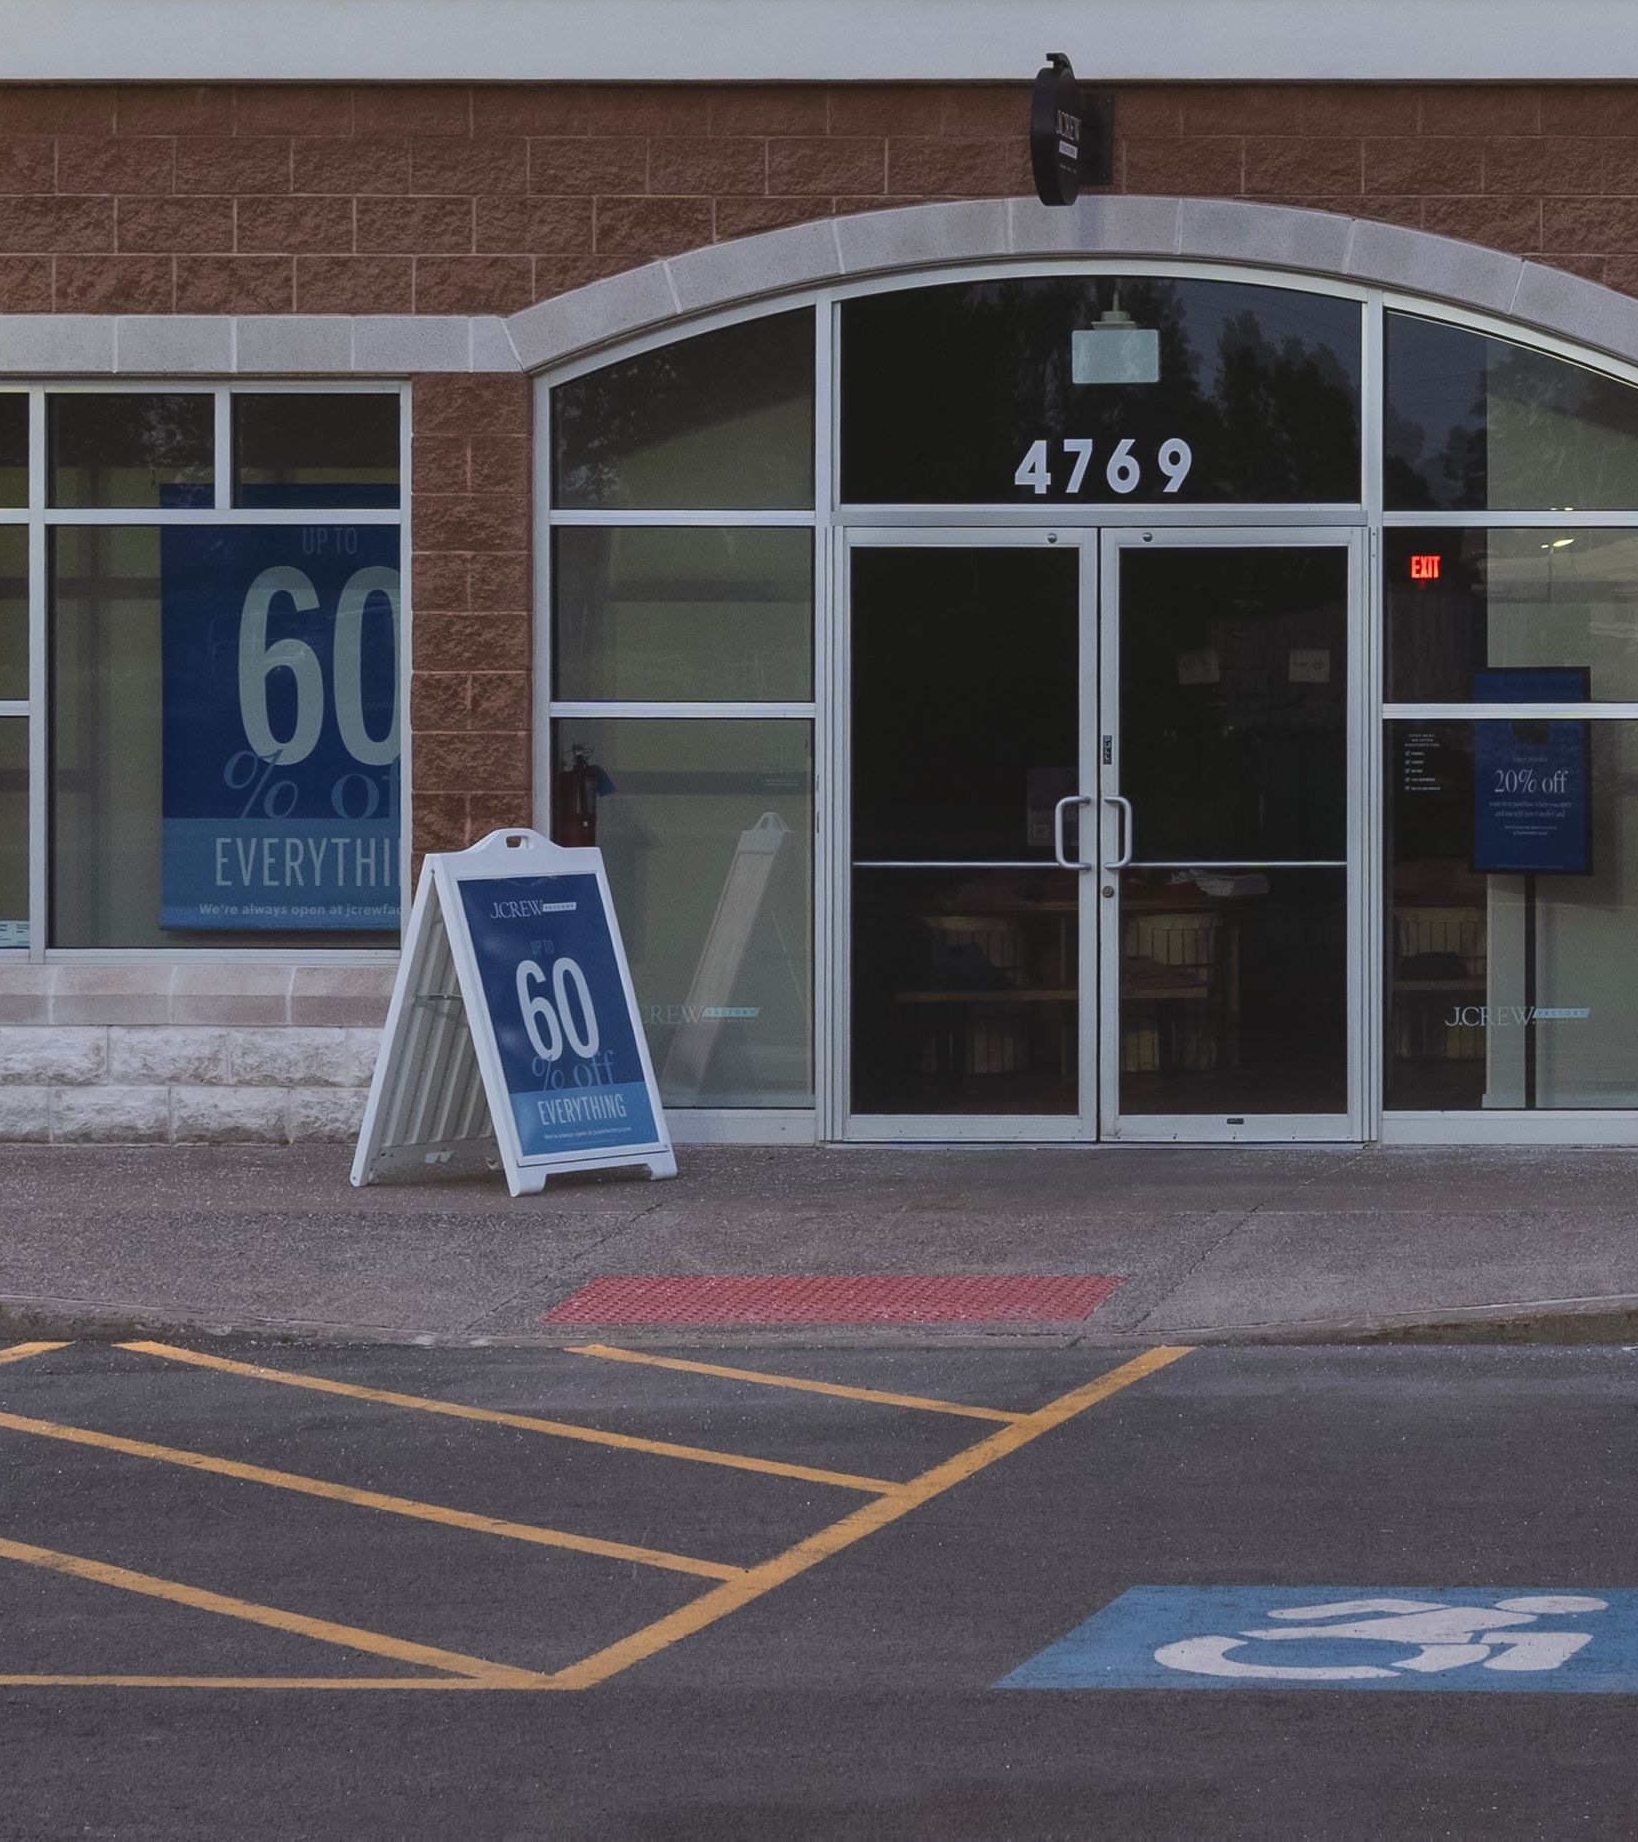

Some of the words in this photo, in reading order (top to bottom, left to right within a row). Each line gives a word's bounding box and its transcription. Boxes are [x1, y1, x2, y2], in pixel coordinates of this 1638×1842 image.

[1013, 437, 1193, 495] 4769
[302, 527, 329, 555] UP
[334, 527, 357, 555] TO
[1411, 555, 1441, 579] EXIT
[238, 565, 401, 766] 60
[330, 758, 401, 821] of
[1493, 769, 1538, 794] 20%
[1541, 770, 1569, 794] off
[215, 837, 401, 887] EVERYTHI
[199, 903, 239, 916] We're
[241, 903, 288, 918] always
[291, 906, 326, 918] open
[329, 904, 343, 916] at
[345, 903, 401, 919] jcrewfac
[490, 900, 543, 919] J.CREW
[515, 957, 600, 1062] 60
[1444, 1005, 1535, 1027] J.CREW
[1537, 1009, 1587, 1017] FACTORY
[573, 1049, 614, 1087] off
[537, 1093, 627, 1126] EVERYTHING
